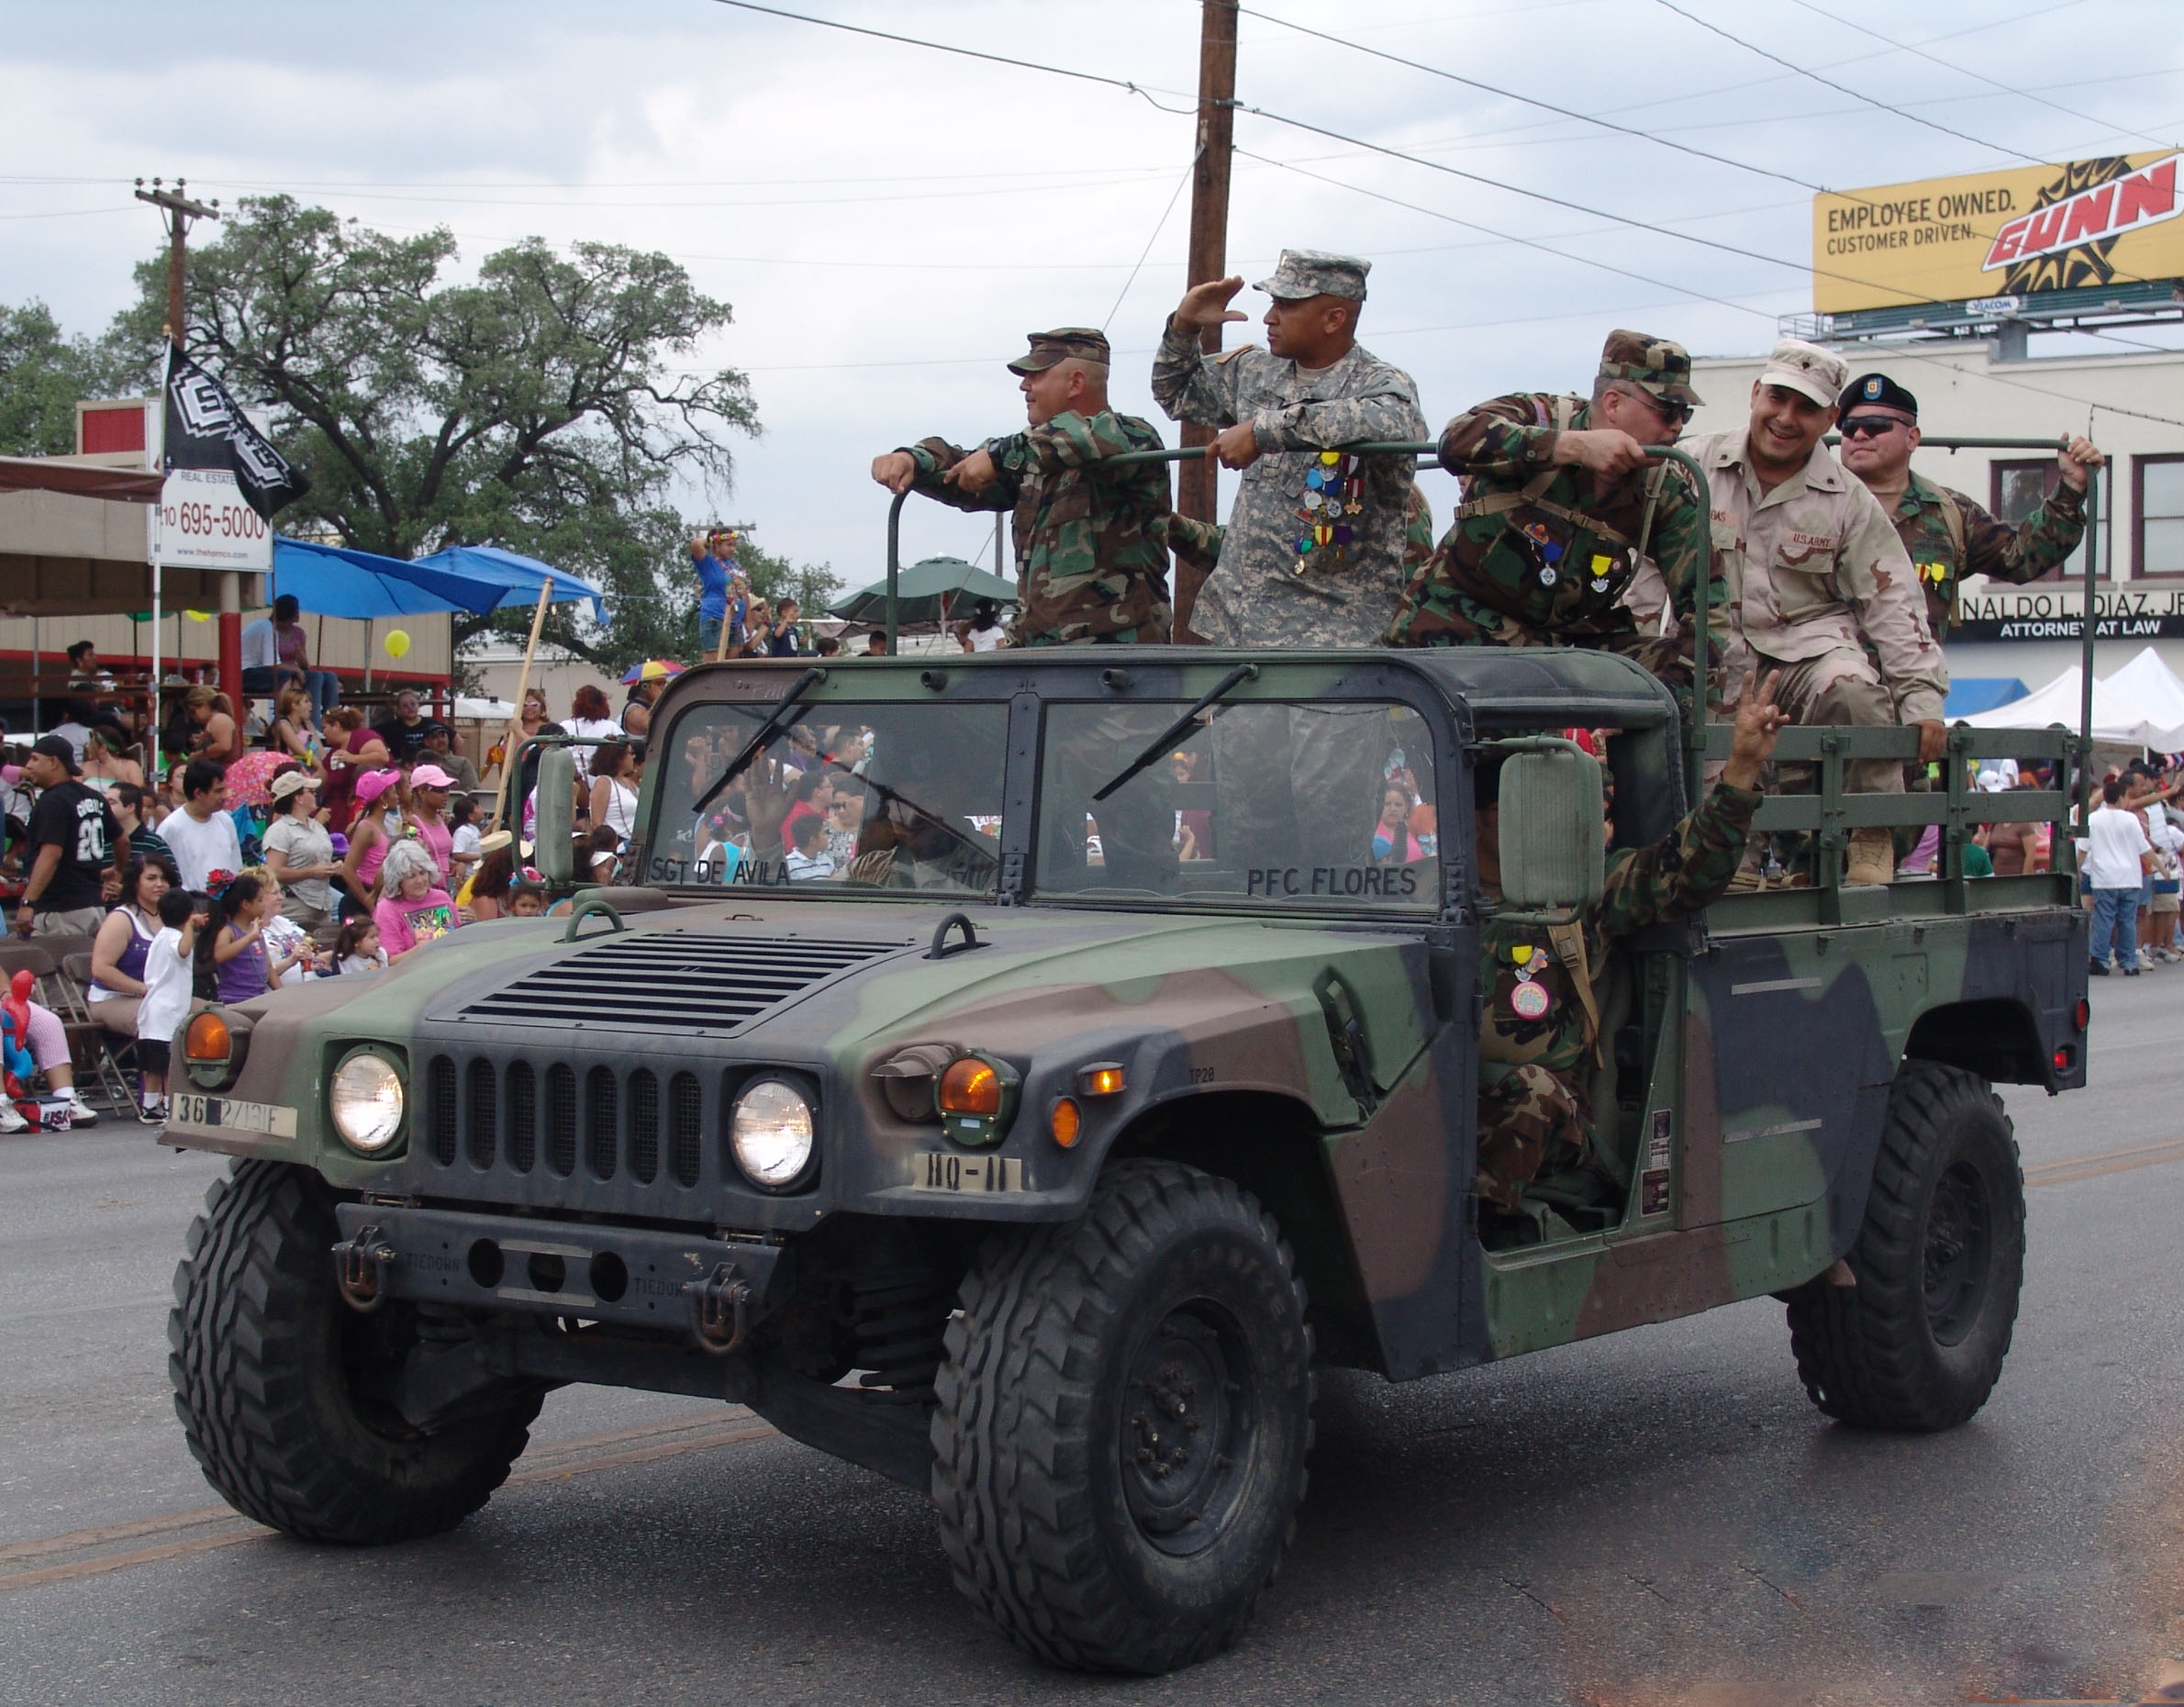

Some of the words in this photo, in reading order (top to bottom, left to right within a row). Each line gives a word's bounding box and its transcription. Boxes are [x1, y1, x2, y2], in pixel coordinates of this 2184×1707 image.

[1829, 198, 1931, 232] EMPLOYEE
[1938, 189, 2016, 219] OWNED.
[1987, 160, 2177, 266] GUNN
[1827, 230, 1908, 255] CUSTOMER
[1914, 223, 1977, 246] DRIVEN.
[1973, 300, 2011, 311] VIACOM
[181, 471, 203, 483] REAL
[206, 473, 236, 485] ESTATE
[162, 507, 176, 527] 10
[181, 502, 264, 540] 695-5000
[2096, 620, 2118, 635] AT
[2122, 619, 2161, 635] LAW
[77, 818, 105, 861] 20
[651, 857, 688, 885] SGT
[697, 859, 724, 886] DE
[733, 859, 791, 886] AVILA
[1248, 867, 1300, 896] PFC
[1311, 866, 1417, 896] FLORES
[179, 1095, 204, 1124] 36
